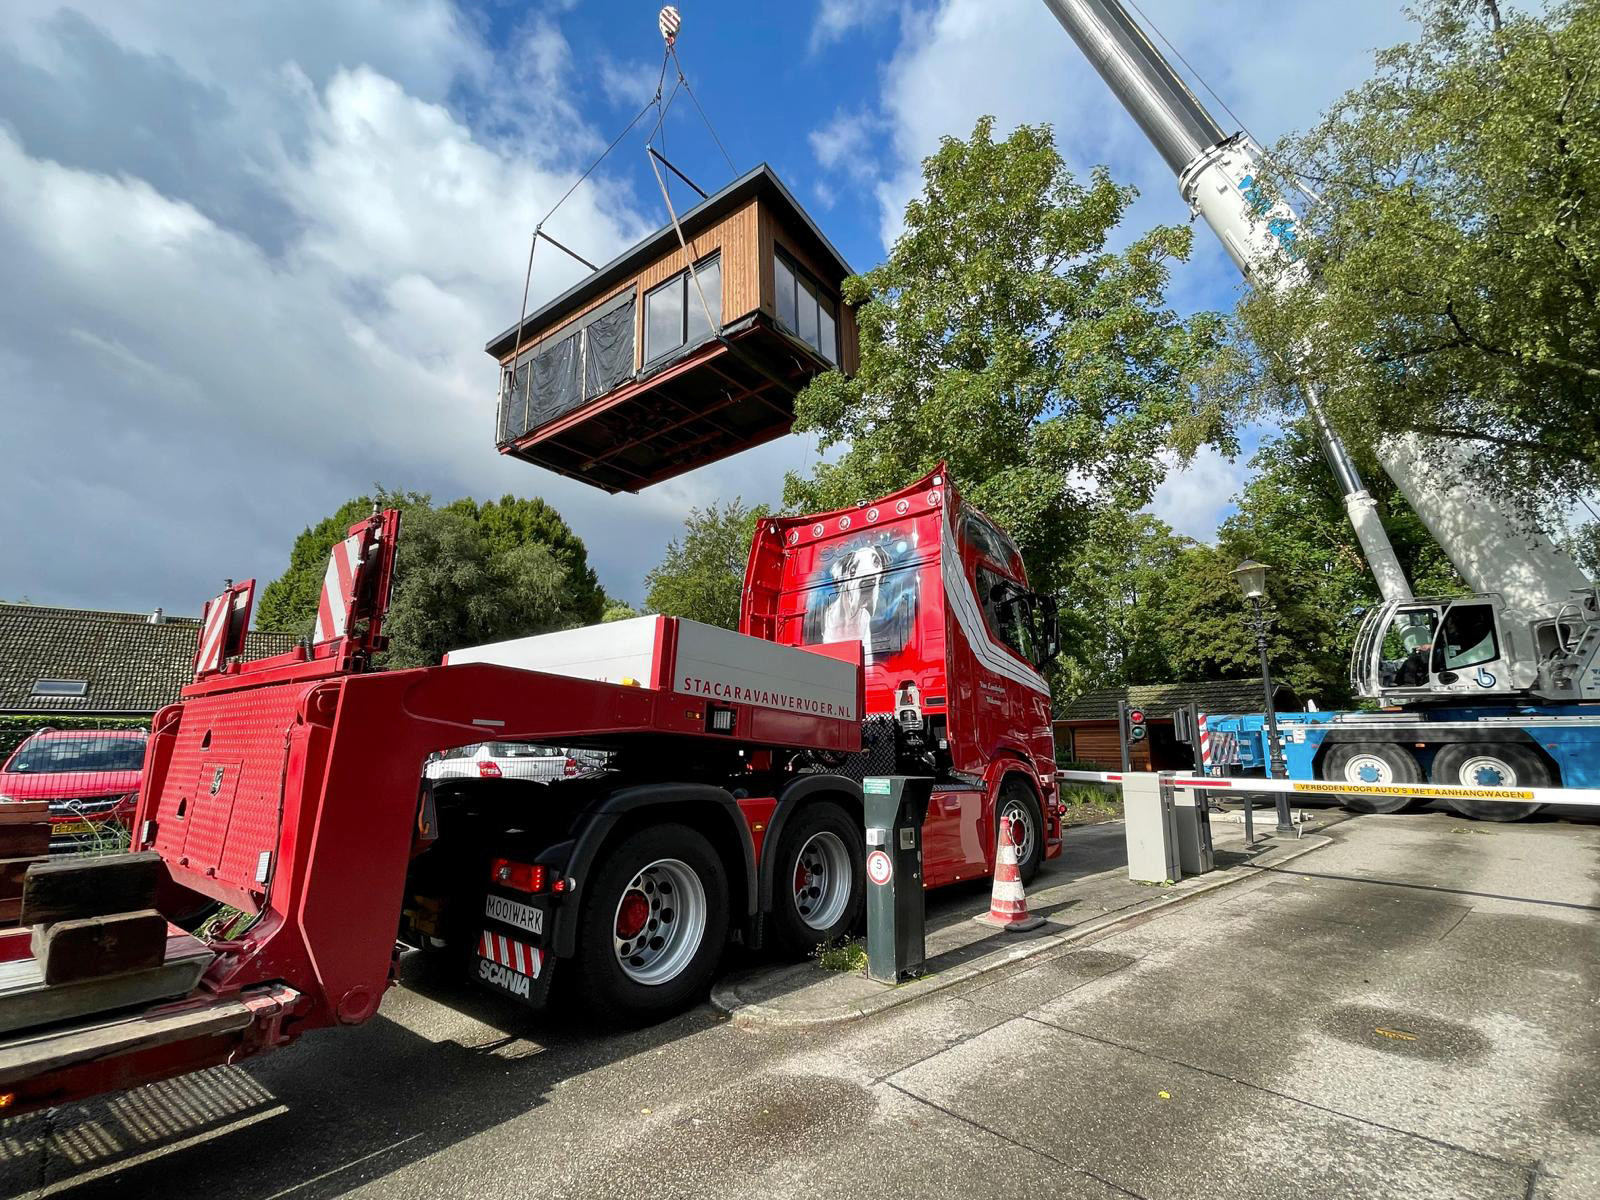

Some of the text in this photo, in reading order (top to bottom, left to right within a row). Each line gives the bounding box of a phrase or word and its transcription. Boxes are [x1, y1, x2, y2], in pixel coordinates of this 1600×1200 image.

[684, 677, 851, 718] STACARAVANVERVOER.NL
[1300, 784, 1525, 799] VERBODEN VOOR AUTO'S MET AANHANGWAGEN
[876, 858, 883, 870] 5
[486, 898, 543, 932] MOOIWARK
[478, 958, 531, 1000] SCANIA
